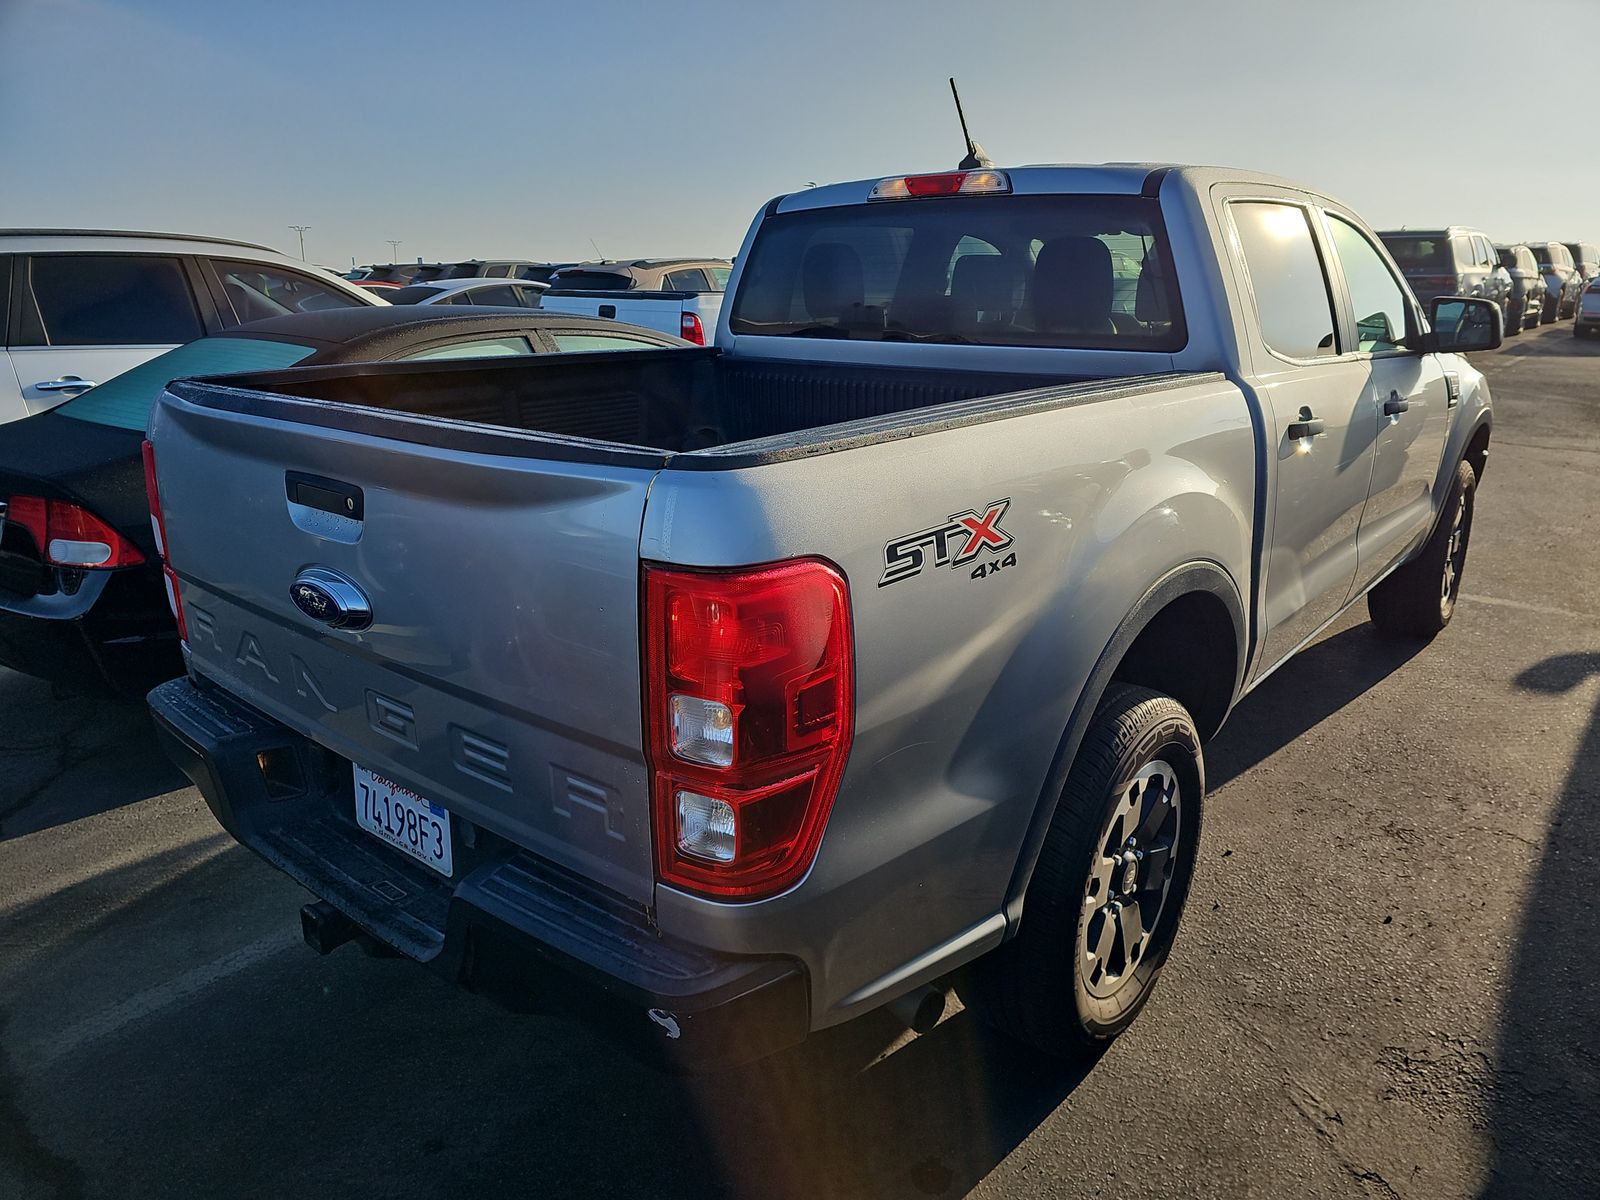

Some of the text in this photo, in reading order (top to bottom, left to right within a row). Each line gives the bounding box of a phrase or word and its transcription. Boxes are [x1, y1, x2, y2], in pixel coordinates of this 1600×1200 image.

[877, 497, 1015, 589] STX
[971, 552, 1017, 580] 4x4
[190, 602, 627, 842] RANGER
[359, 782, 444, 859] 74198F3
